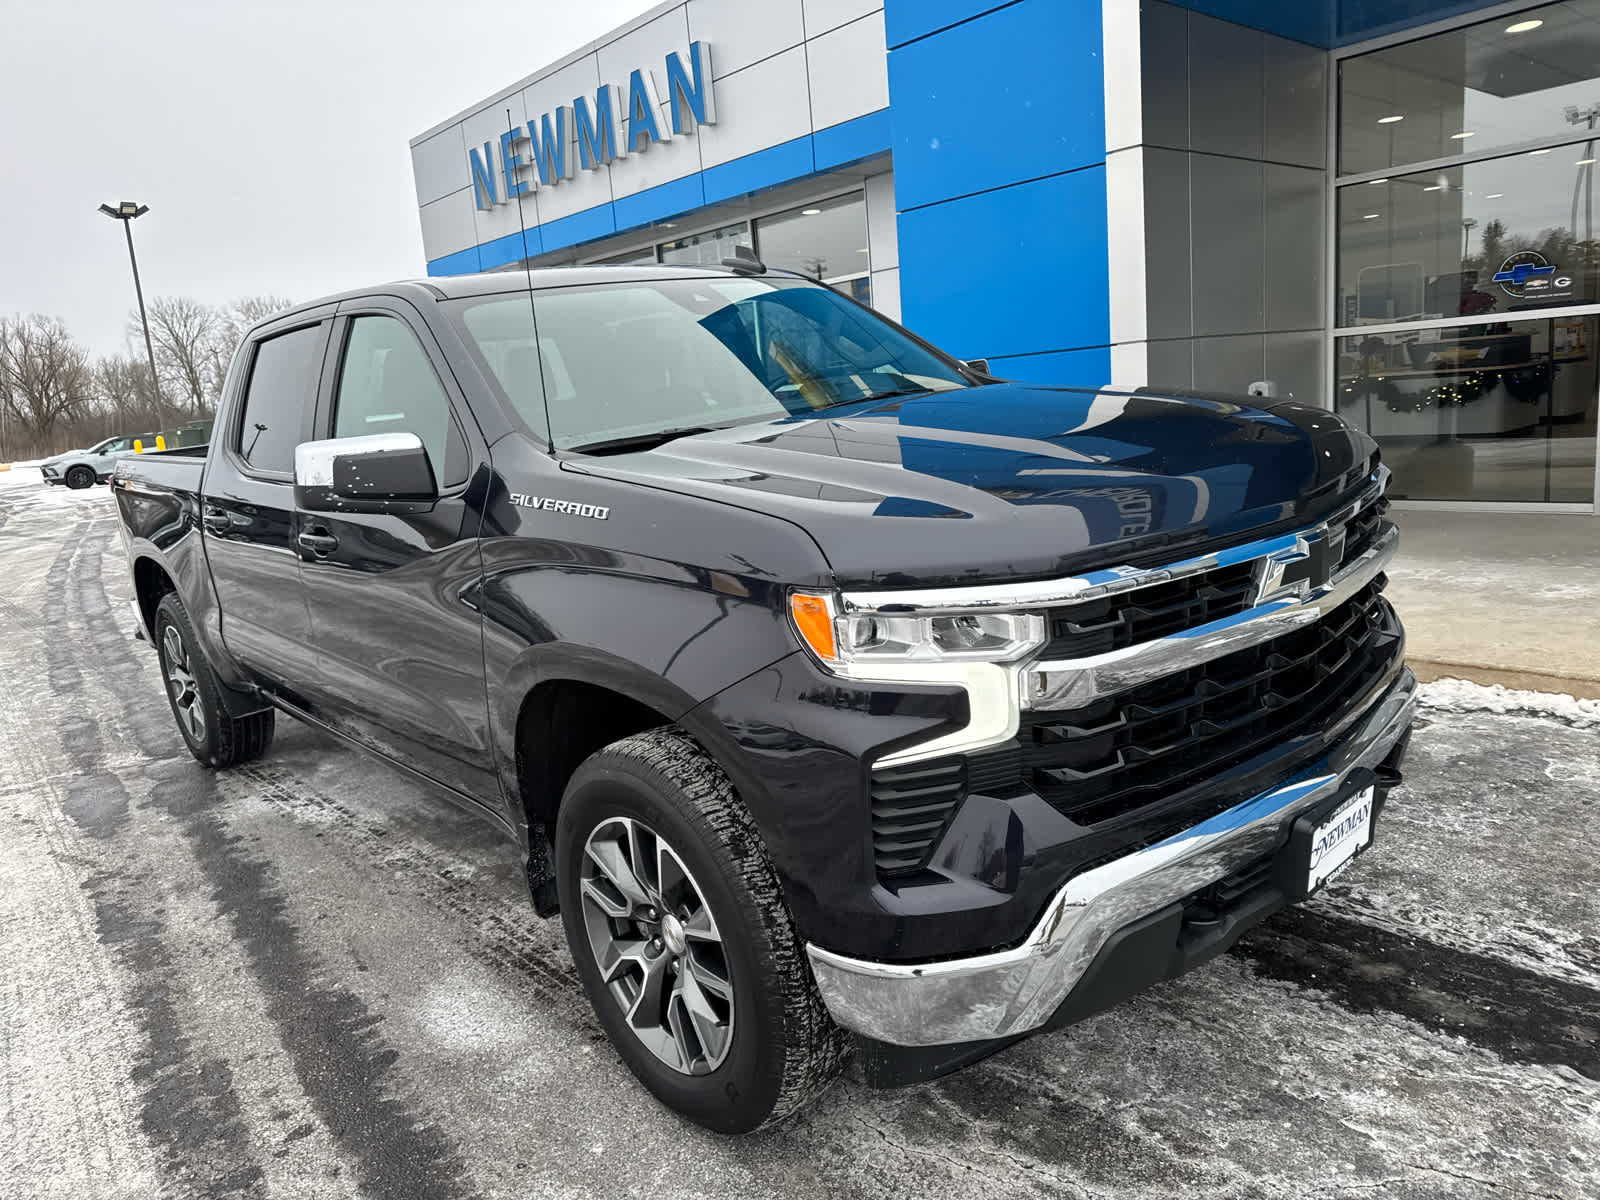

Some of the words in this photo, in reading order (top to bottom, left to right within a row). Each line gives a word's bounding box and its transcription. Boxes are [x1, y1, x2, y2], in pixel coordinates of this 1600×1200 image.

[469, 40, 716, 211] NEWMAN
[508, 493, 610, 520] SILVERADO
[1318, 801, 1371, 852] NEWMAN
